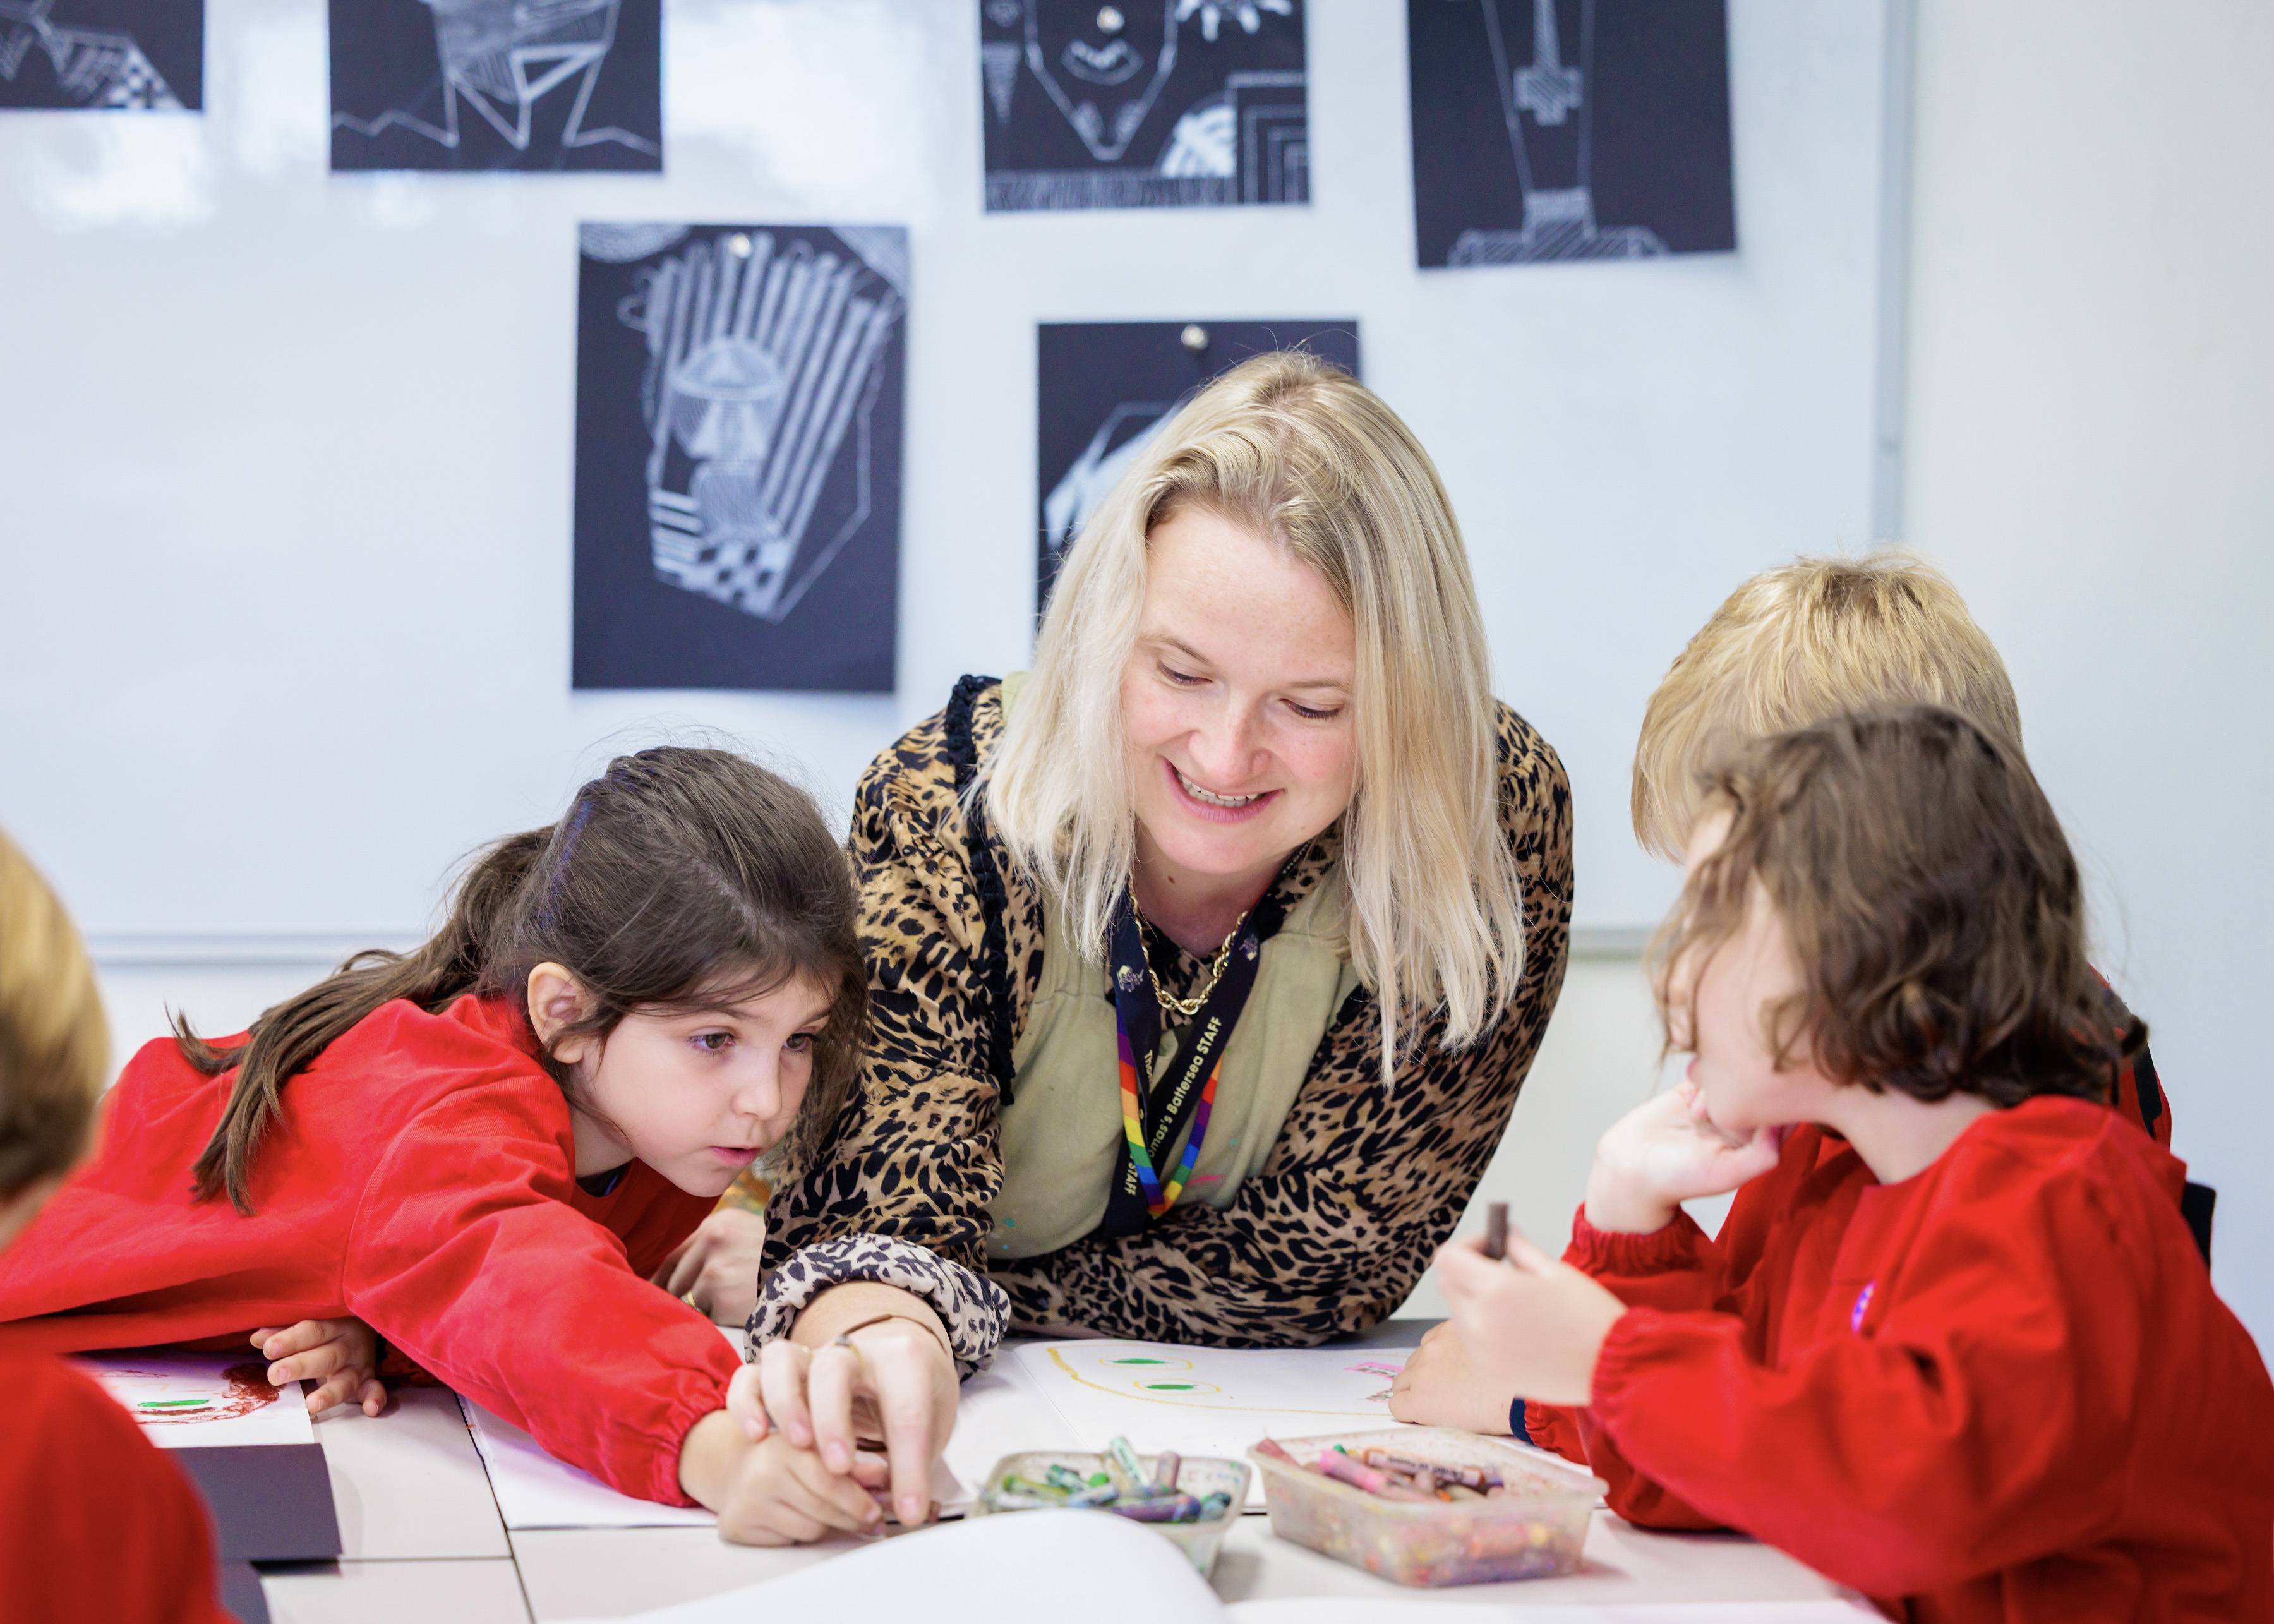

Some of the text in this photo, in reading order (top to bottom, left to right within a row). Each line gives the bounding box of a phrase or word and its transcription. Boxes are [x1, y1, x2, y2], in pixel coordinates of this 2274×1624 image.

[1166, 1055, 1204, 1115] Battersea
[1196, 1016, 1222, 1054] STAFF
[1124, 1162, 1138, 1196] STAFF
